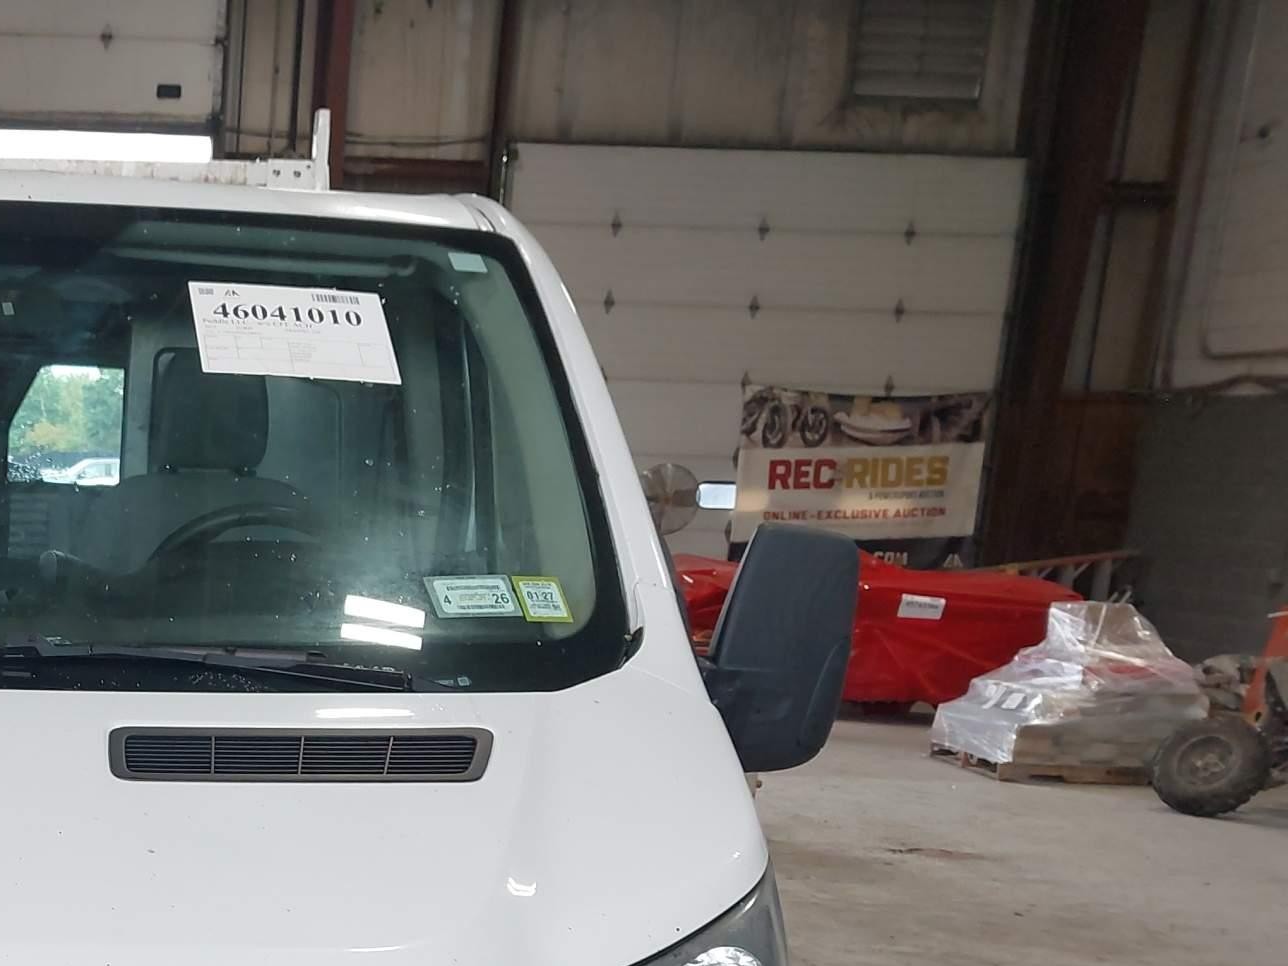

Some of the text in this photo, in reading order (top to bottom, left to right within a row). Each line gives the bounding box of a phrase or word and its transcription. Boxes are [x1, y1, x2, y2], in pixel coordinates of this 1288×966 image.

[213, 302, 362, 327] 46041010
[768, 456, 949, 490] REC RIDES
[893, 506, 946, 518] AUCTION
[443, 593, 510, 605] 4 26
